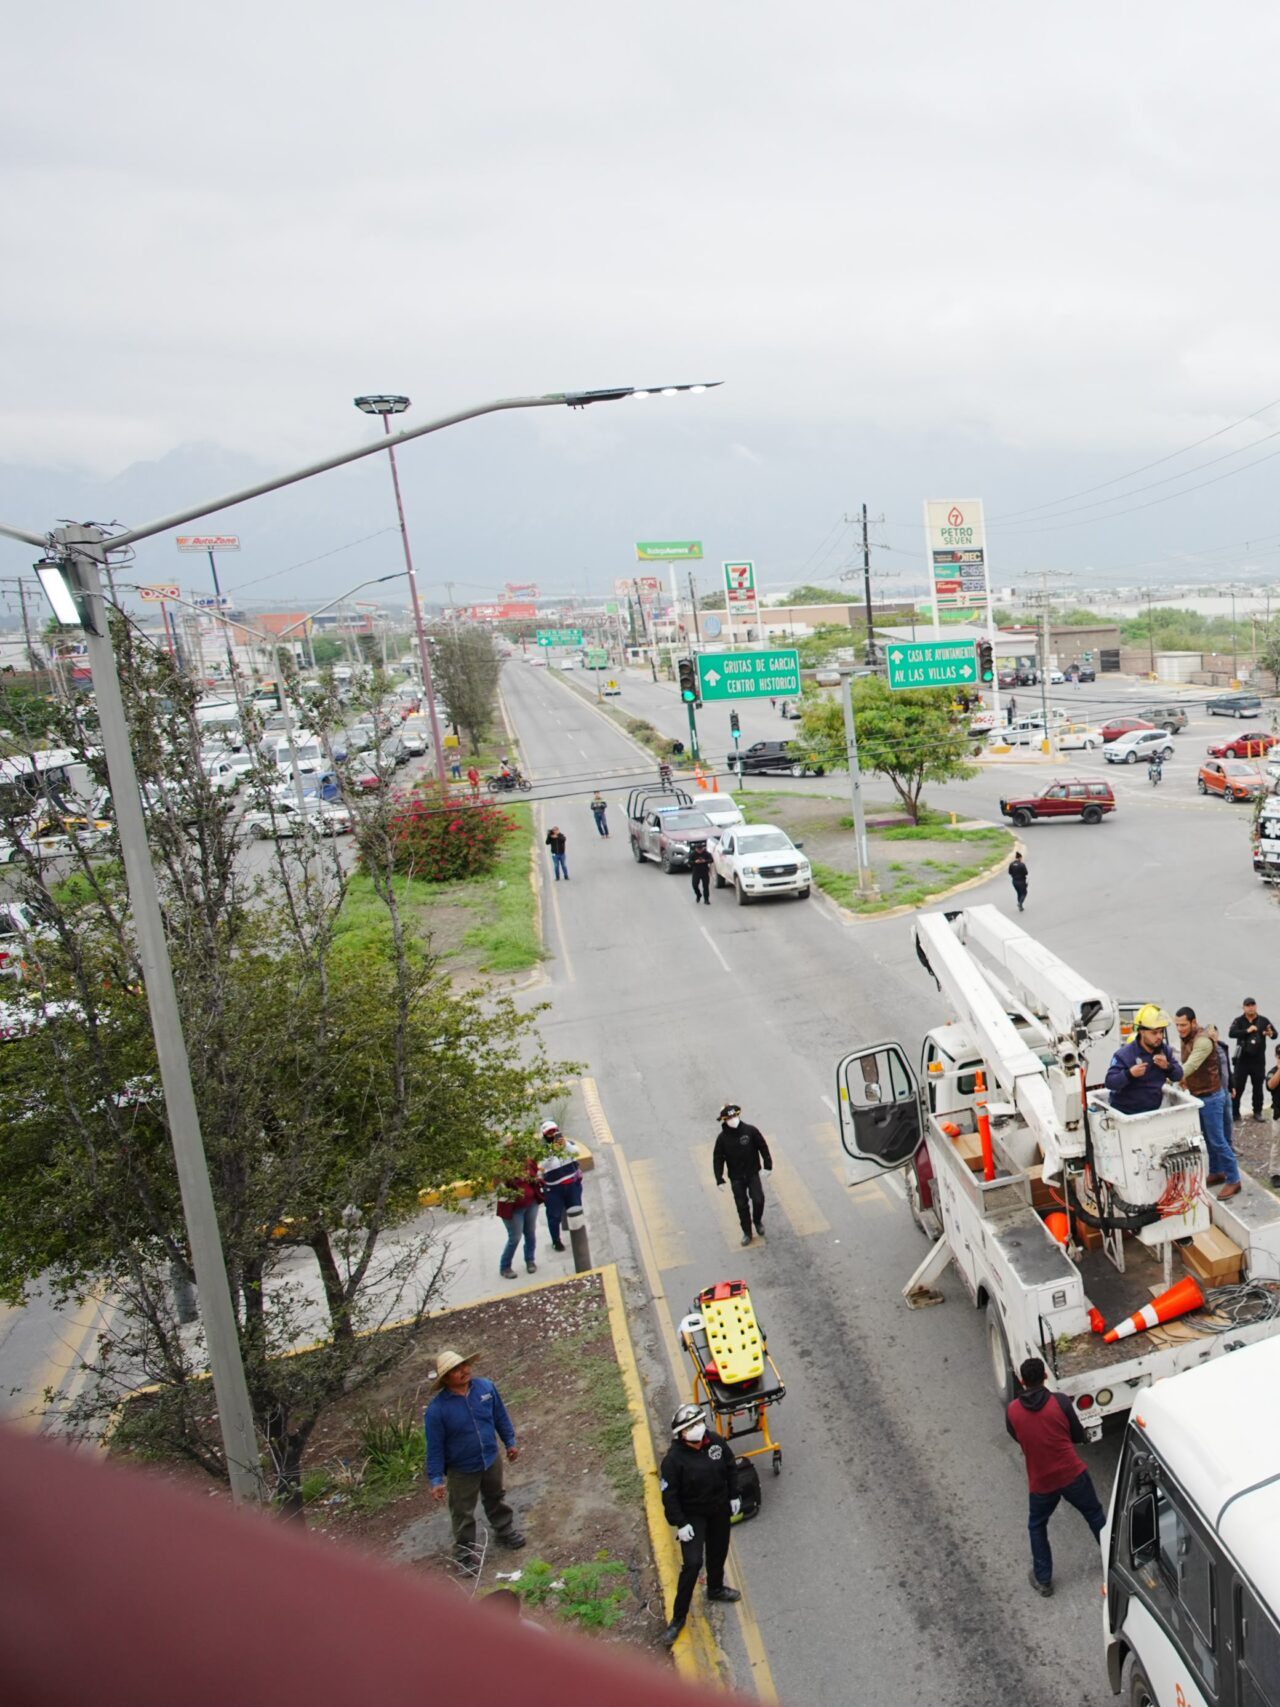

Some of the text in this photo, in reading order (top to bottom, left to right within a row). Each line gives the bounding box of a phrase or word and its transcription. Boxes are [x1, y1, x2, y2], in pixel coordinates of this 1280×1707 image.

[941, 528, 973, 537] PETRO
[192, 537, 236, 545] AutoZone
[943, 537, 972, 545] SEVEN
[907, 650, 923, 662] CASA
[925, 649, 933, 661] DE
[723, 657, 796, 674] GRUTAS DE GARCIA
[895, 666, 957, 683] AV. LAS VILLAS
[727, 676, 796, 693] CENTRO HISTORICO
